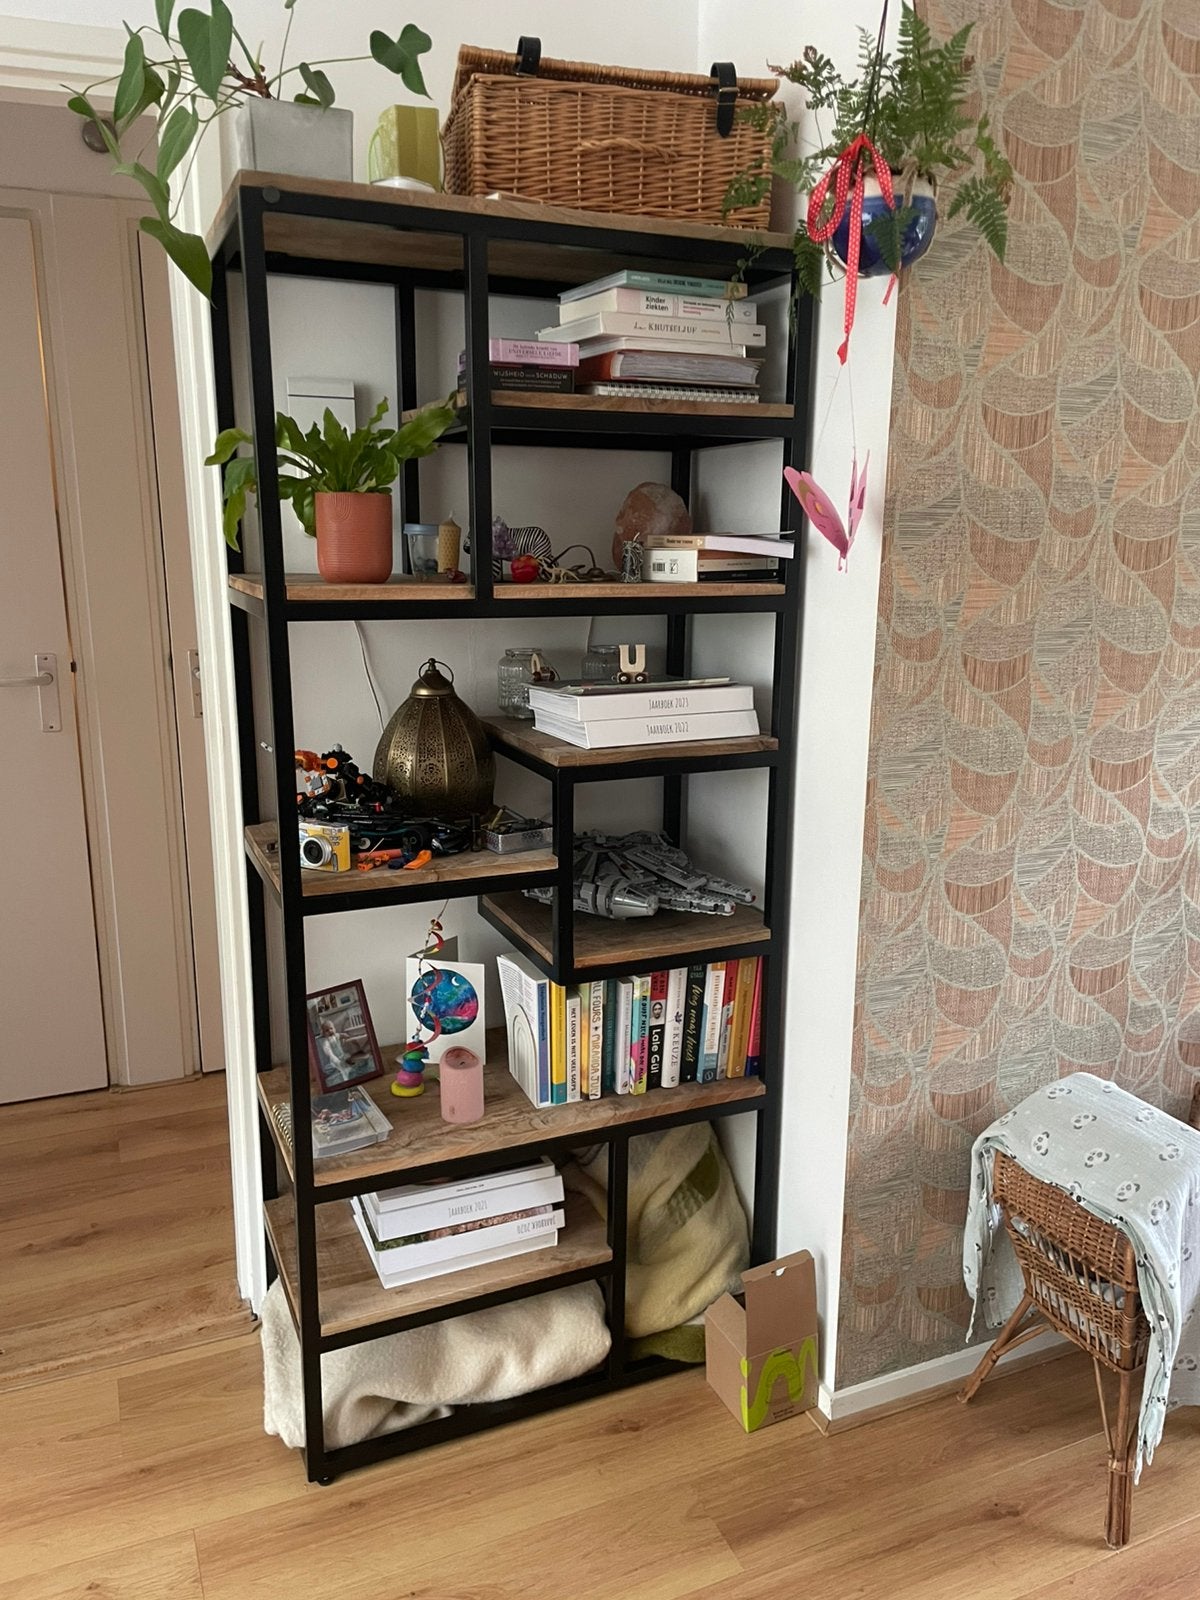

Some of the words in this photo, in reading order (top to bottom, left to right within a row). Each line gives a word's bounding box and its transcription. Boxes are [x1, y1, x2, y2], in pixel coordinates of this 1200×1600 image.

[645, 295, 666, 304] Kinder
[645, 304, 669, 312] ziekten
[648, 699, 673, 710] JAARBOEK
[646, 724, 673, 736] JAARBOEK
[690, 984, 703, 1006] Weg
[592, 995, 601, 1023] FOURS
[687, 1009, 697, 1035] naar
[651, 1029, 661, 1052] Lale
[671, 1033, 680, 1067] KEUZE
[685, 1036, 697, 1062] huis
[591, 1034, 600, 1073] MIRANDA
[650, 1054, 660, 1073] Gül
[590, 1075, 600, 1096] JULY
[448, 1205, 473, 1218] JAARBOEK
